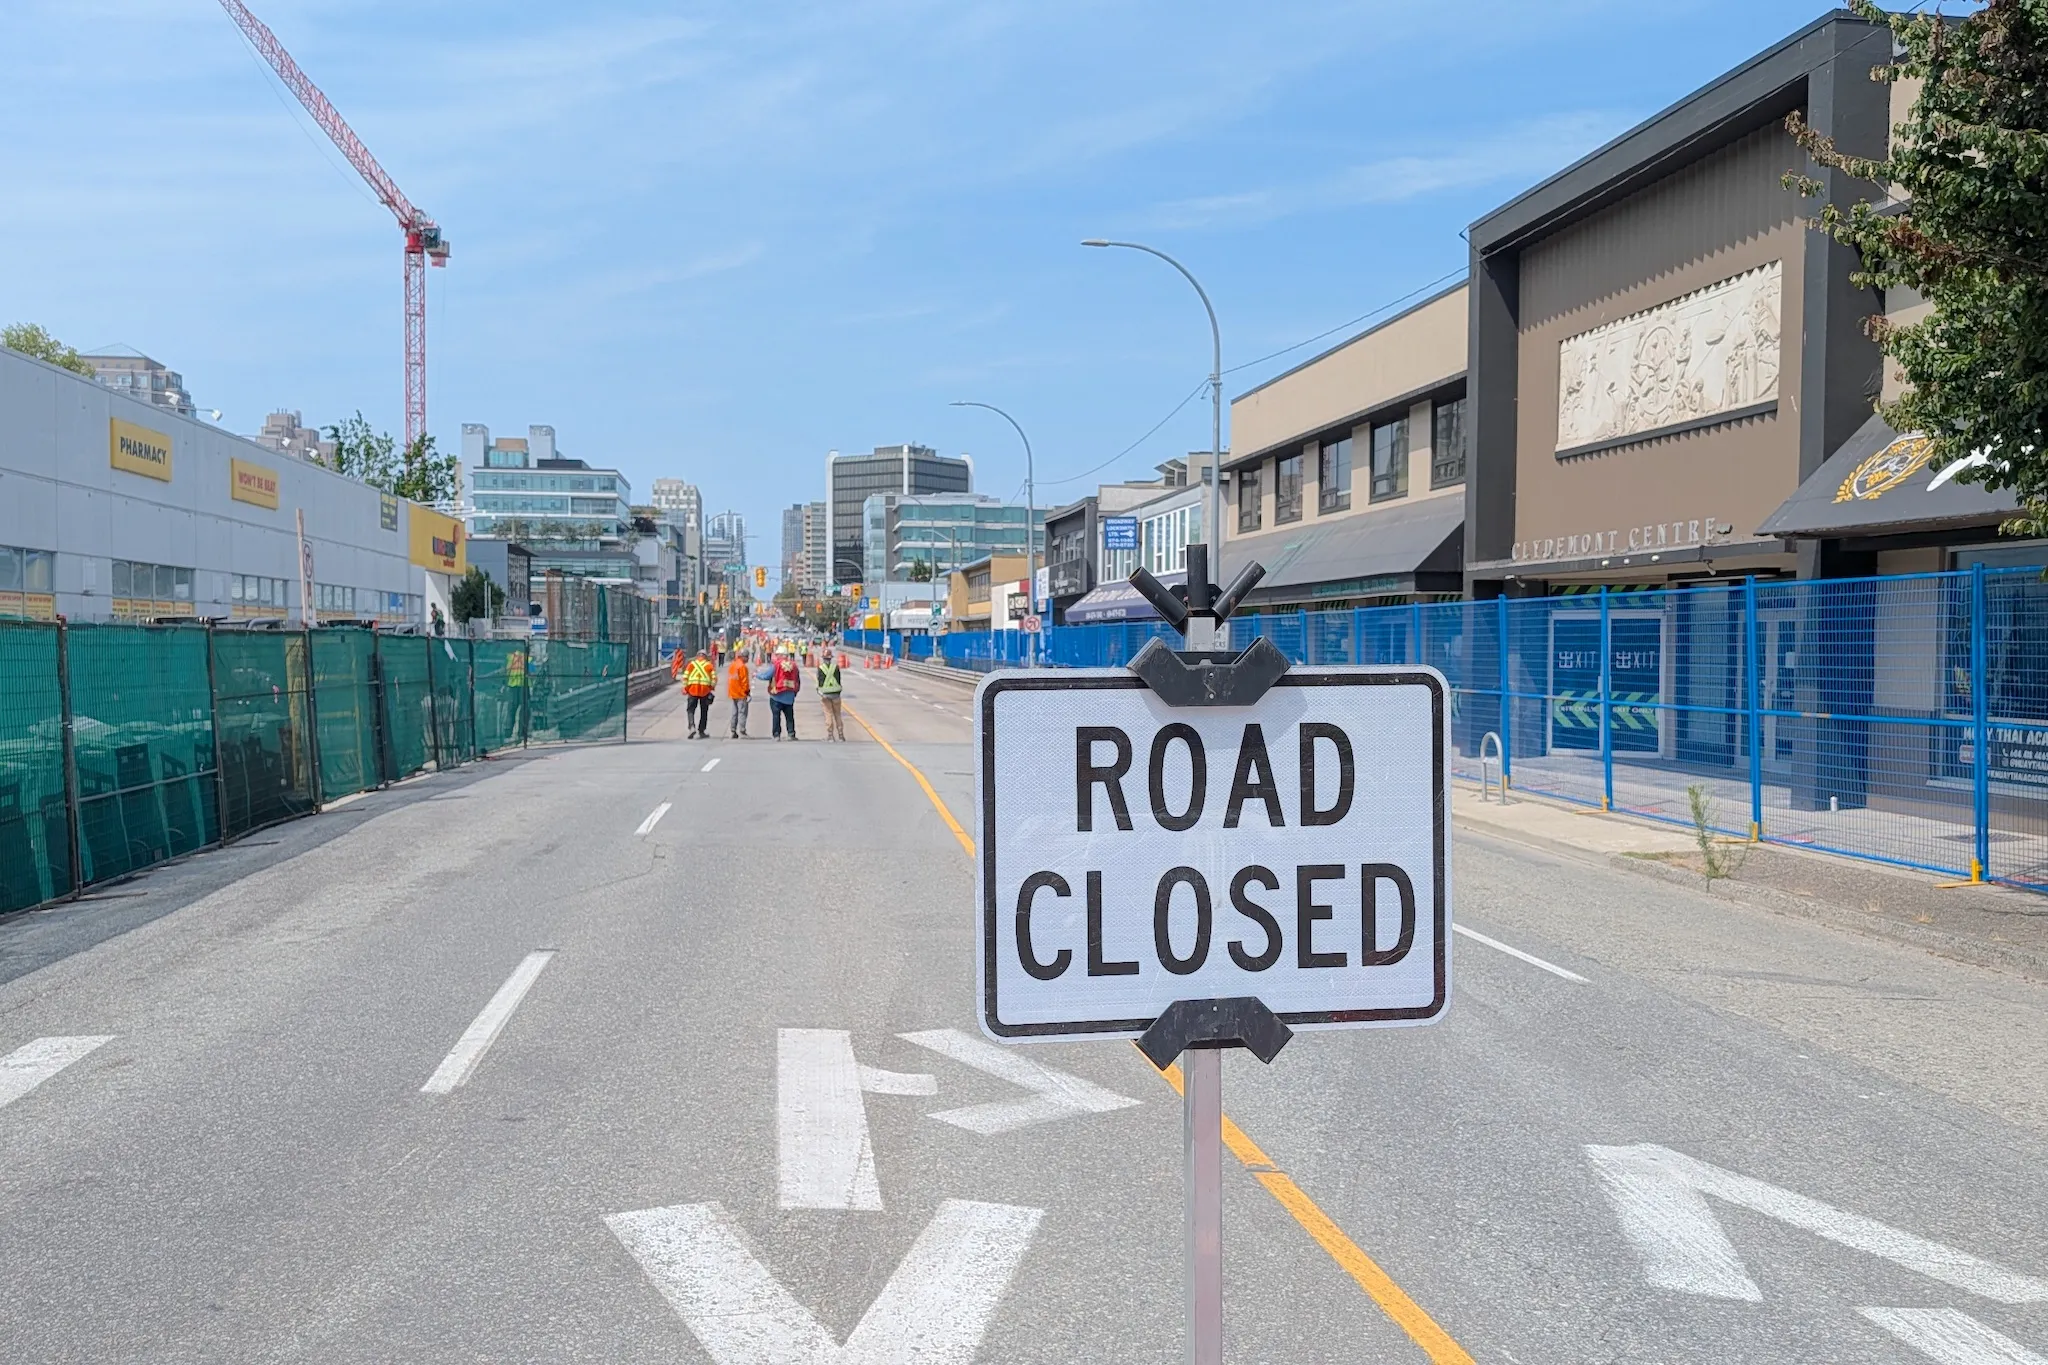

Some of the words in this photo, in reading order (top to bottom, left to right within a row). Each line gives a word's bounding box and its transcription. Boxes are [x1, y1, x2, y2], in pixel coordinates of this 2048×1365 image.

[120, 436, 167, 465] PHARMACY
[238, 470, 257, 487] WON'T
[1511, 530, 1618, 561] CLYDEMONT
[1629, 517, 1716, 547] CENTRE
[1632, 706, 1654, 714] ONLY
[1996, 728, 2023, 744] THAI
[1076, 722, 1355, 833] ROAD
[1015, 863, 1416, 981] CLOSED
